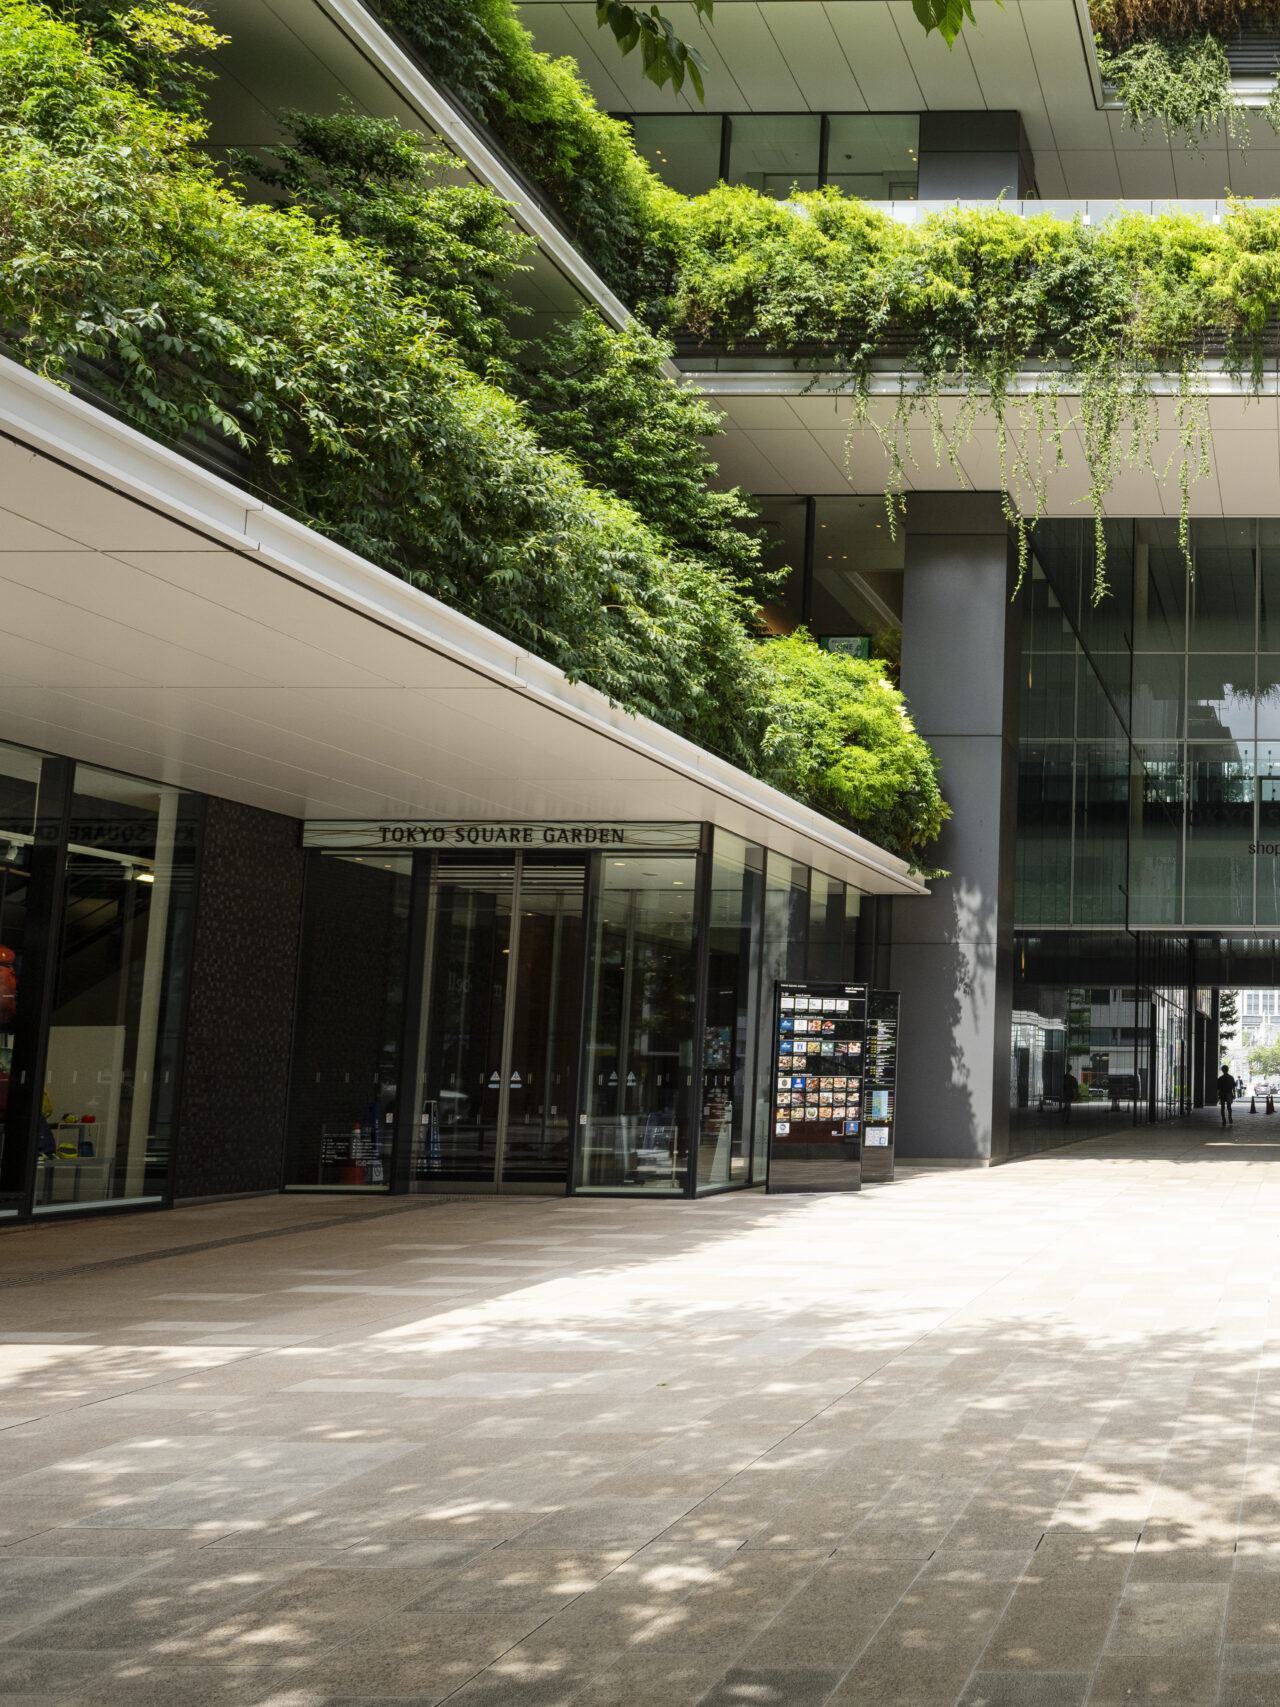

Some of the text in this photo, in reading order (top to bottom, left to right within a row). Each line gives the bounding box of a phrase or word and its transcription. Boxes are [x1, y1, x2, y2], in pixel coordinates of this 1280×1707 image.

[379, 827, 624, 844] TOKYO SQUARE GARDEN
